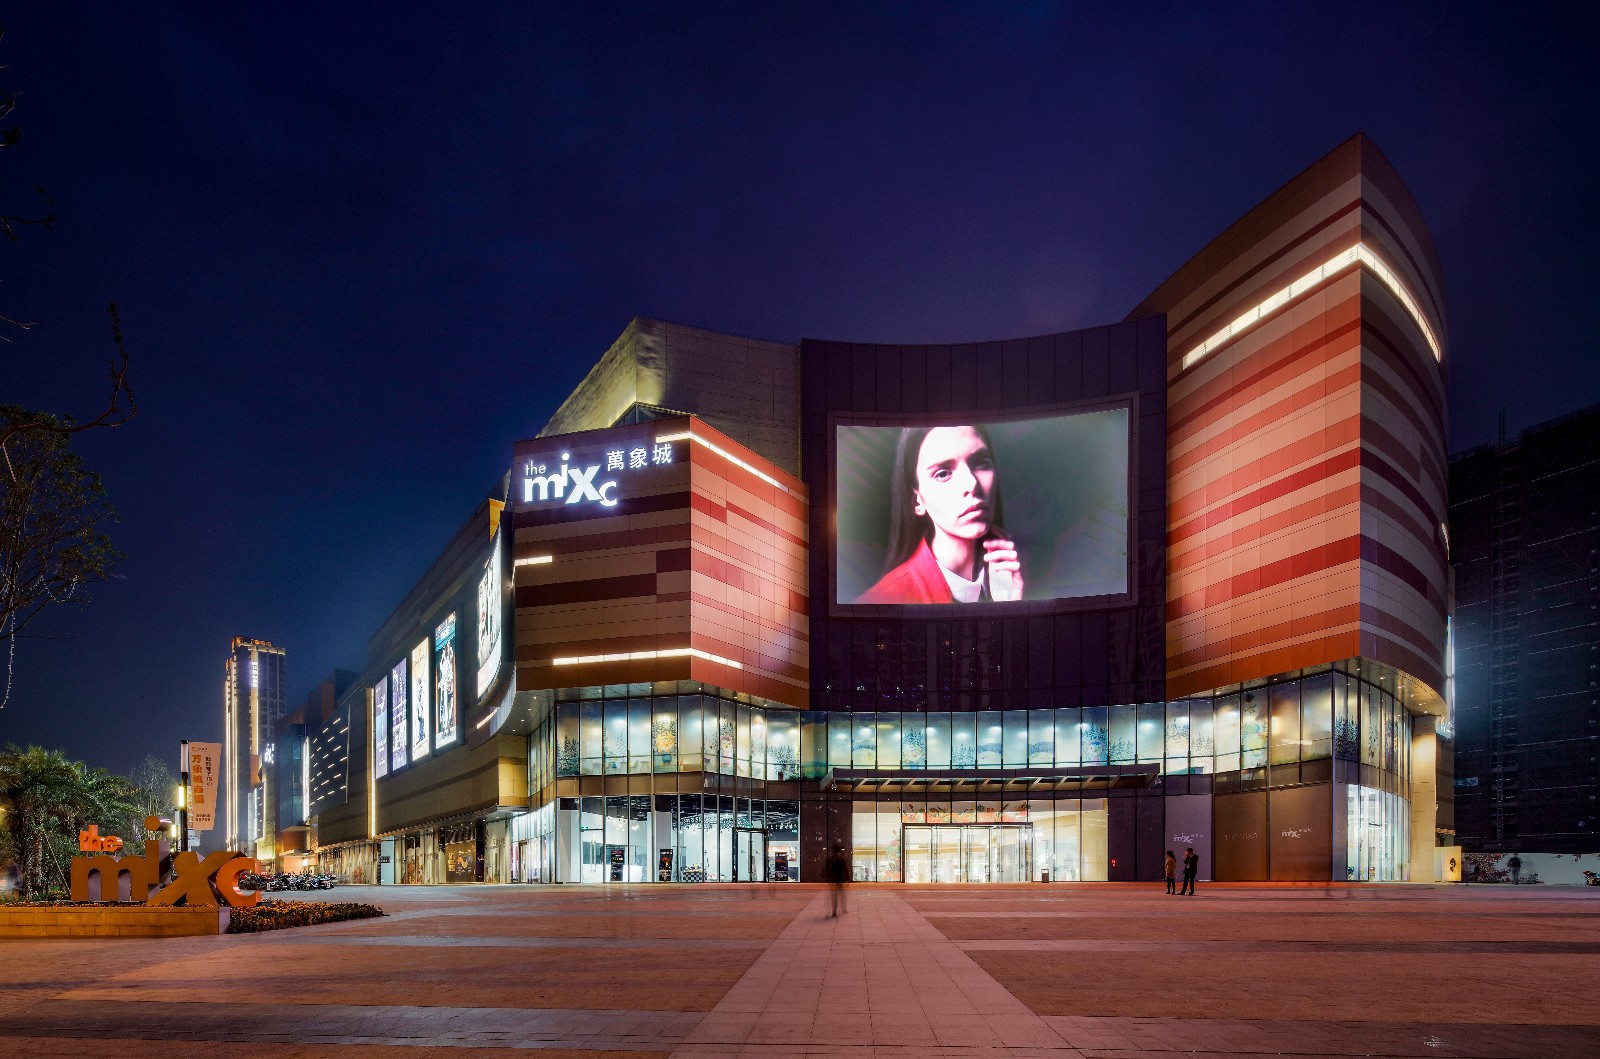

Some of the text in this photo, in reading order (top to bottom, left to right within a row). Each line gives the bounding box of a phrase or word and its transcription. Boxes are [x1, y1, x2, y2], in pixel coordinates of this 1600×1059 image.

[525, 460, 547, 476] the
[607, 444, 672, 471] 萬象城
[79, 825, 123, 852] the
